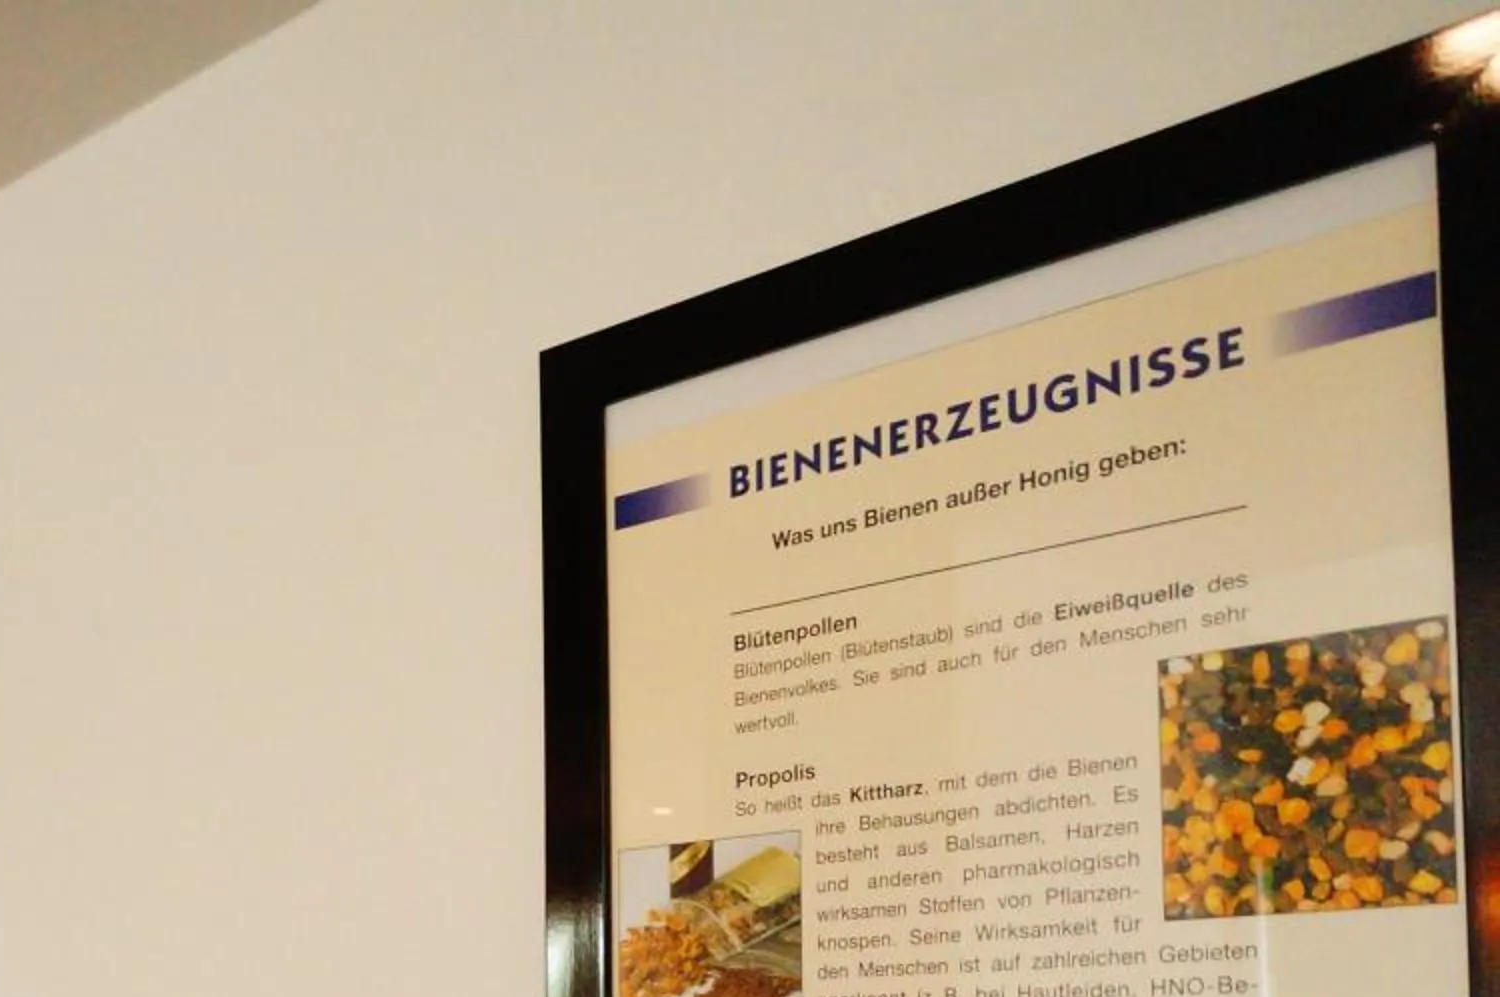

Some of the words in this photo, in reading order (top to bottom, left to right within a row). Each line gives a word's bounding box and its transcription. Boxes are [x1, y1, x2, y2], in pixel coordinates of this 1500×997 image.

[729, 326, 1245, 499] BIENENERZEUGNISSE
[771, 527, 815, 551] Was
[819, 517, 858, 539] uns
[863, 498, 939, 529] Bienen
[945, 479, 1013, 509] außer
[1019, 460, 1091, 493] Honig
[1098, 439, 1187, 478] geben:
[733, 649, 833, 680] Blütenpollen
[839, 624, 954, 664] (Blütenstaub)
[963, 615, 1003, 638] sind
[1013, 611, 1044, 630] die
[1053, 580, 1195, 622] Eiweißquelle
[1206, 573, 1249, 594] des
[733, 615, 858, 653] Blütenpollen
[852, 668, 881, 688] Sie
[889, 658, 928, 682] sind
[936, 651, 983, 674] auch
[992, 643, 1020, 664] für
[1029, 638, 1068, 658] den
[1078, 617, 1188, 649] Menschen
[1200, 605, 1250, 628] sehr
[733, 710, 799, 735] wertvoll.
[734, 799, 757, 817] So
[763, 793, 804, 814] heißt
[809, 789, 842, 810] das
[937, 774, 968, 793] mit
[974, 770, 1019, 789] dem
[1027, 764, 1058, 783] die
[1067, 755, 1138, 778] Bienen
[735, 763, 816, 790] Propolis
[815, 819, 847, 838] ihre
[857, 805, 980, 833] Behausungen
[1112, 784, 1140, 805] Es
[815, 842, 880, 866] besteht
[895, 839, 929, 858] aus
[1065, 820, 1140, 842] Harzen
[815, 873, 850, 896] und
[866, 868, 943, 891] anderen
[962, 848, 1141, 887] pharmakologisch
[815, 902, 908, 924] wirksamen
[918, 894, 986, 916] Stoffen
[996, 893, 1033, 910] von
[1044, 885, 1141, 906] Pflanzen-
[908, 927, 962, 947] Seine
[974, 916, 1099, 943] Wirksamkeit
[1112, 915, 1142, 934] für
[816, 963, 850, 981] den
[857, 958, 950, 979] Menschen
[958, 955, 981, 974] ist
[990, 952, 1021, 974] auf
[1030, 947, 1147, 972] zahlreichen
[1157, 943, 1259, 964] Gebieten
